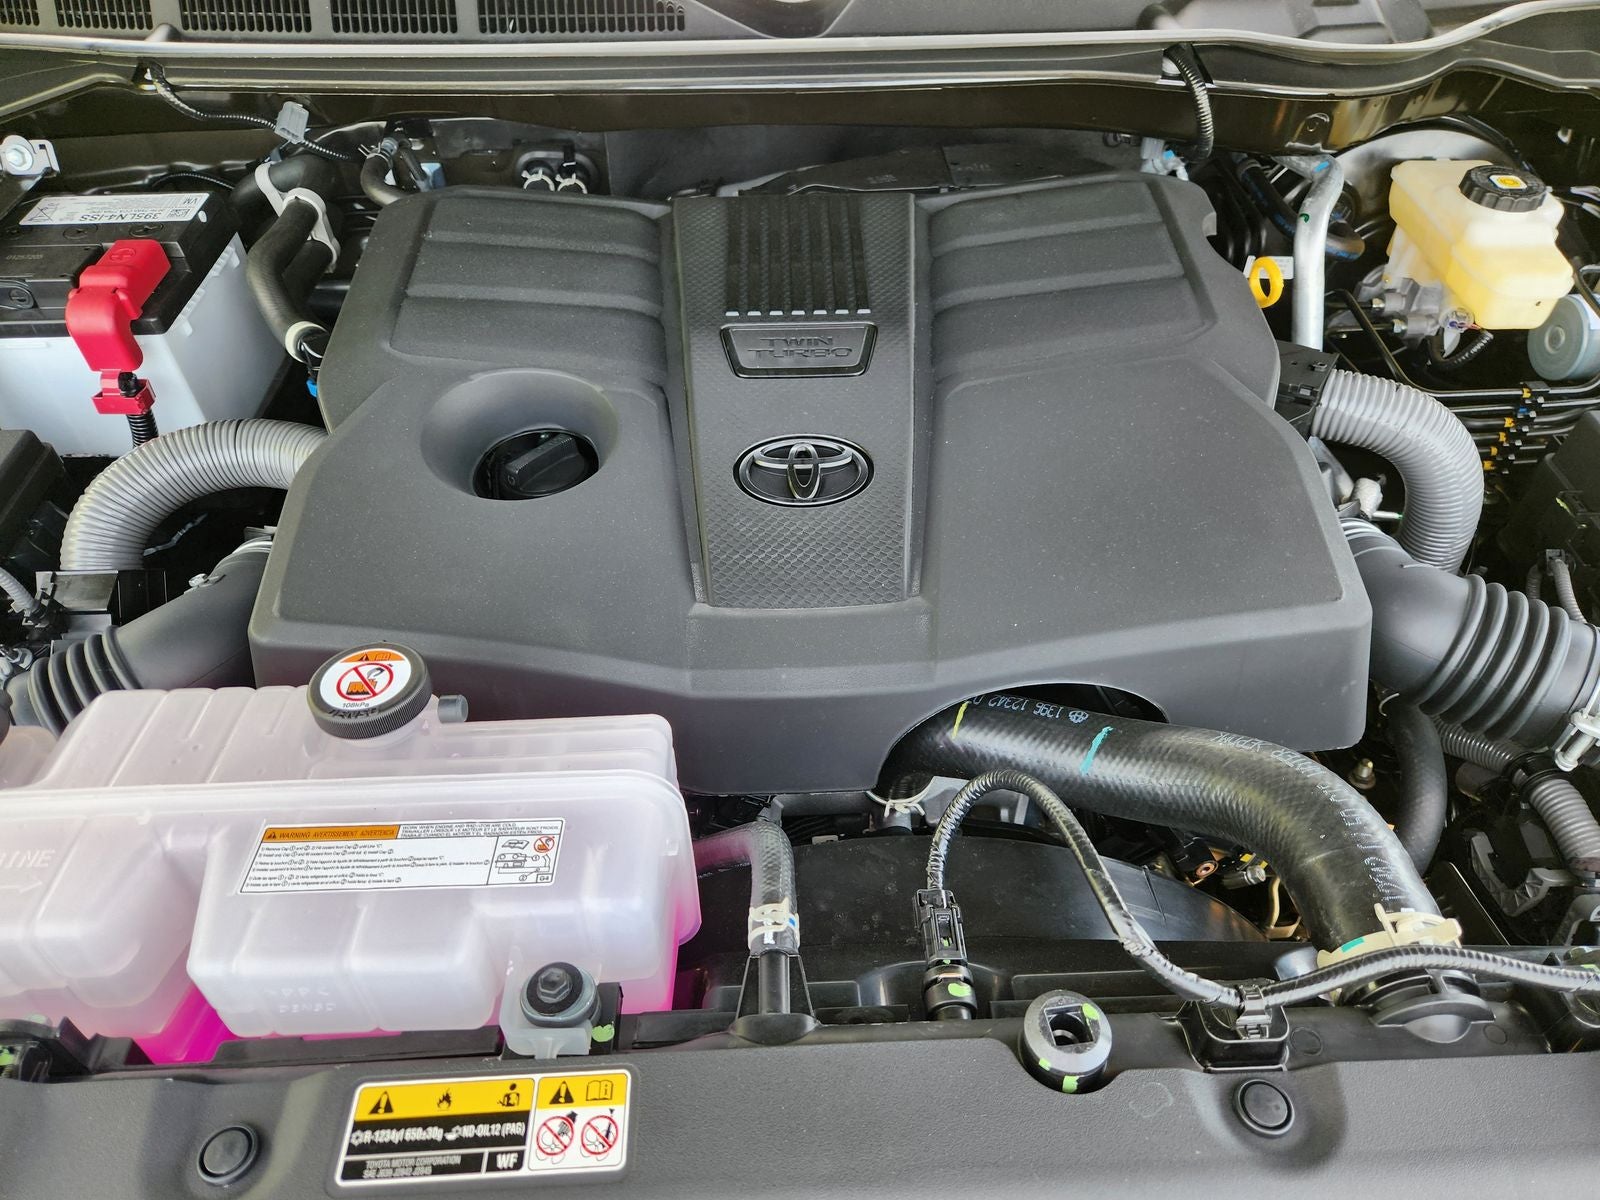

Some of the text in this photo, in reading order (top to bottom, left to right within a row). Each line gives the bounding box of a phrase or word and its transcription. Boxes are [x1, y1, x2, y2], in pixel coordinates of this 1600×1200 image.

[80, 212, 162, 222] 395LN4-ISS
[760, 336, 834, 347] TWIN
[748, 347, 852, 358] TURBO
[988, 696, 1029, 712] 12342
[1033, 702, 1064, 719] 1396
[279, 830, 310, 839] WARNING
[313, 830, 357, 838] AVERTISSEMENT
[363, 1127, 404, 1144] R-1234yf
[502, 1122, 525, 1137] (PAG)
[366, 1153, 518, 1169] TOYOTA MOTOR CORPORATION WF
